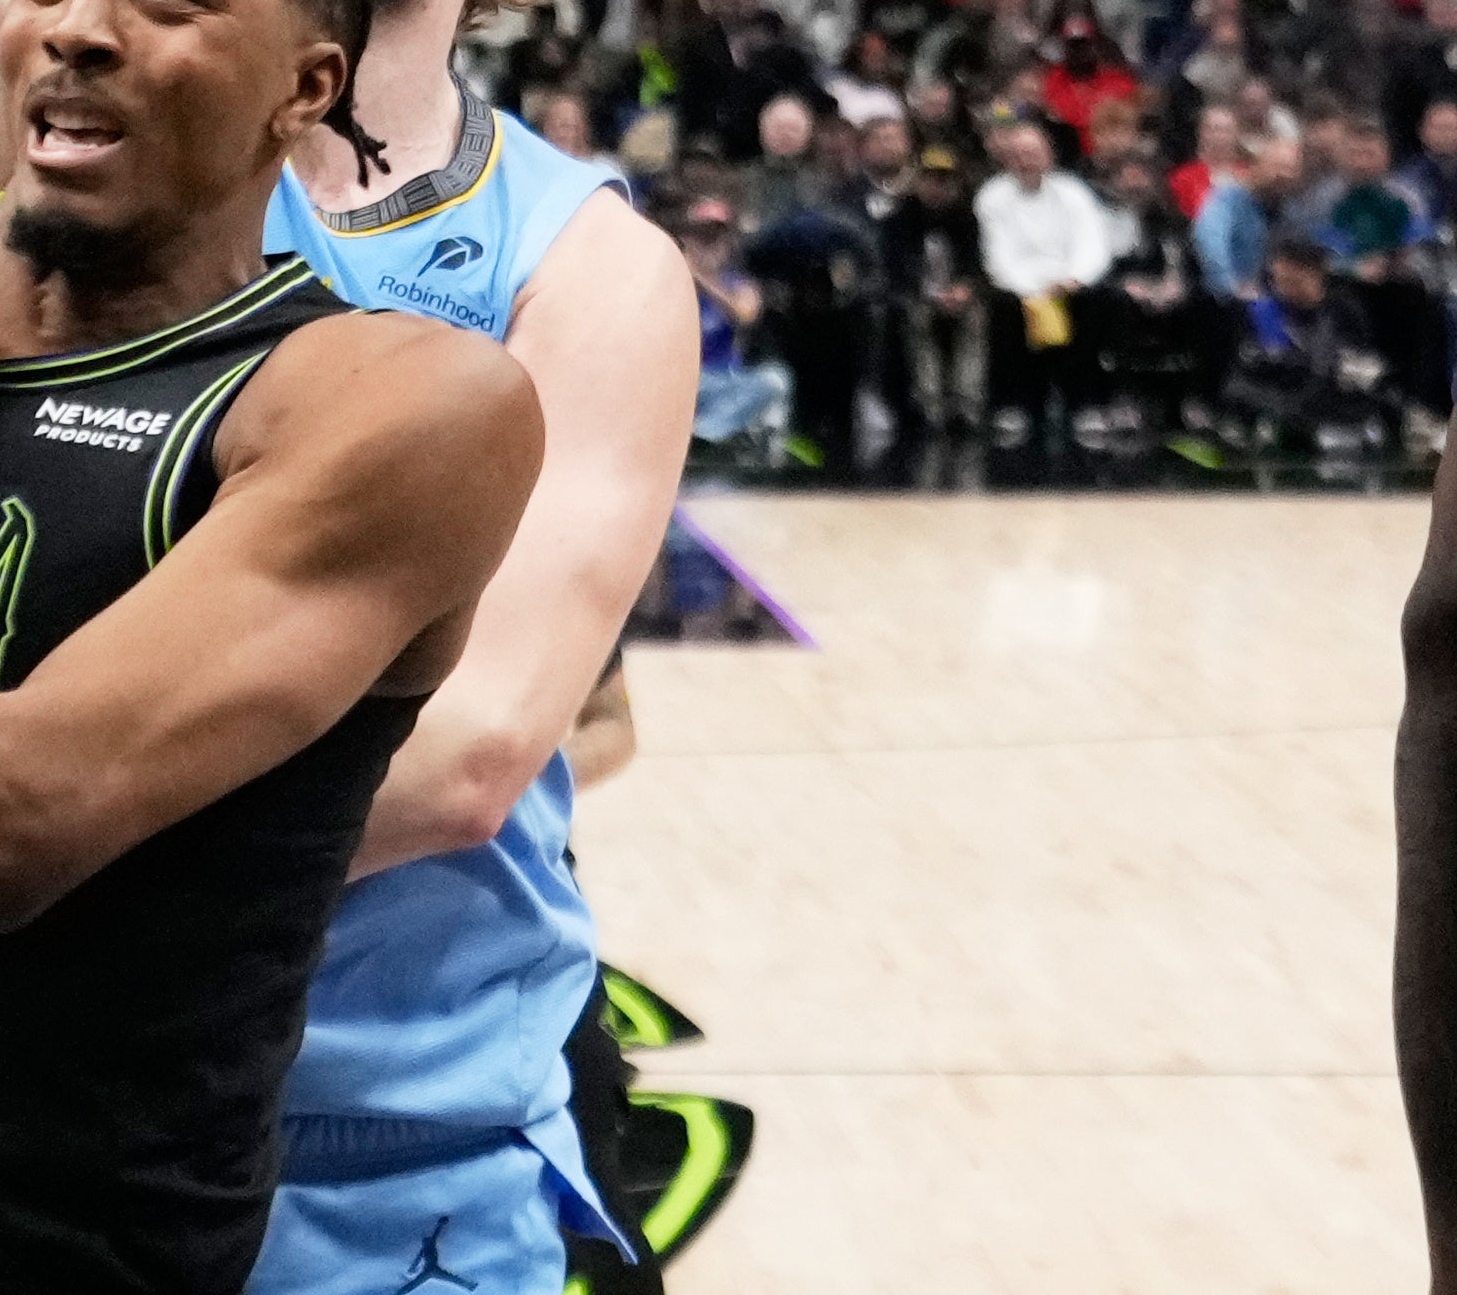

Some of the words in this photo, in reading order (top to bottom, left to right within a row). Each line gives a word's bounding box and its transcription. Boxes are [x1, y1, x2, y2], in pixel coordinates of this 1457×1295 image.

[378, 276, 495, 332] Robinhood
[35, 397, 172, 435] NEWAGE
[34, 424, 143, 453] PRODUCTS
